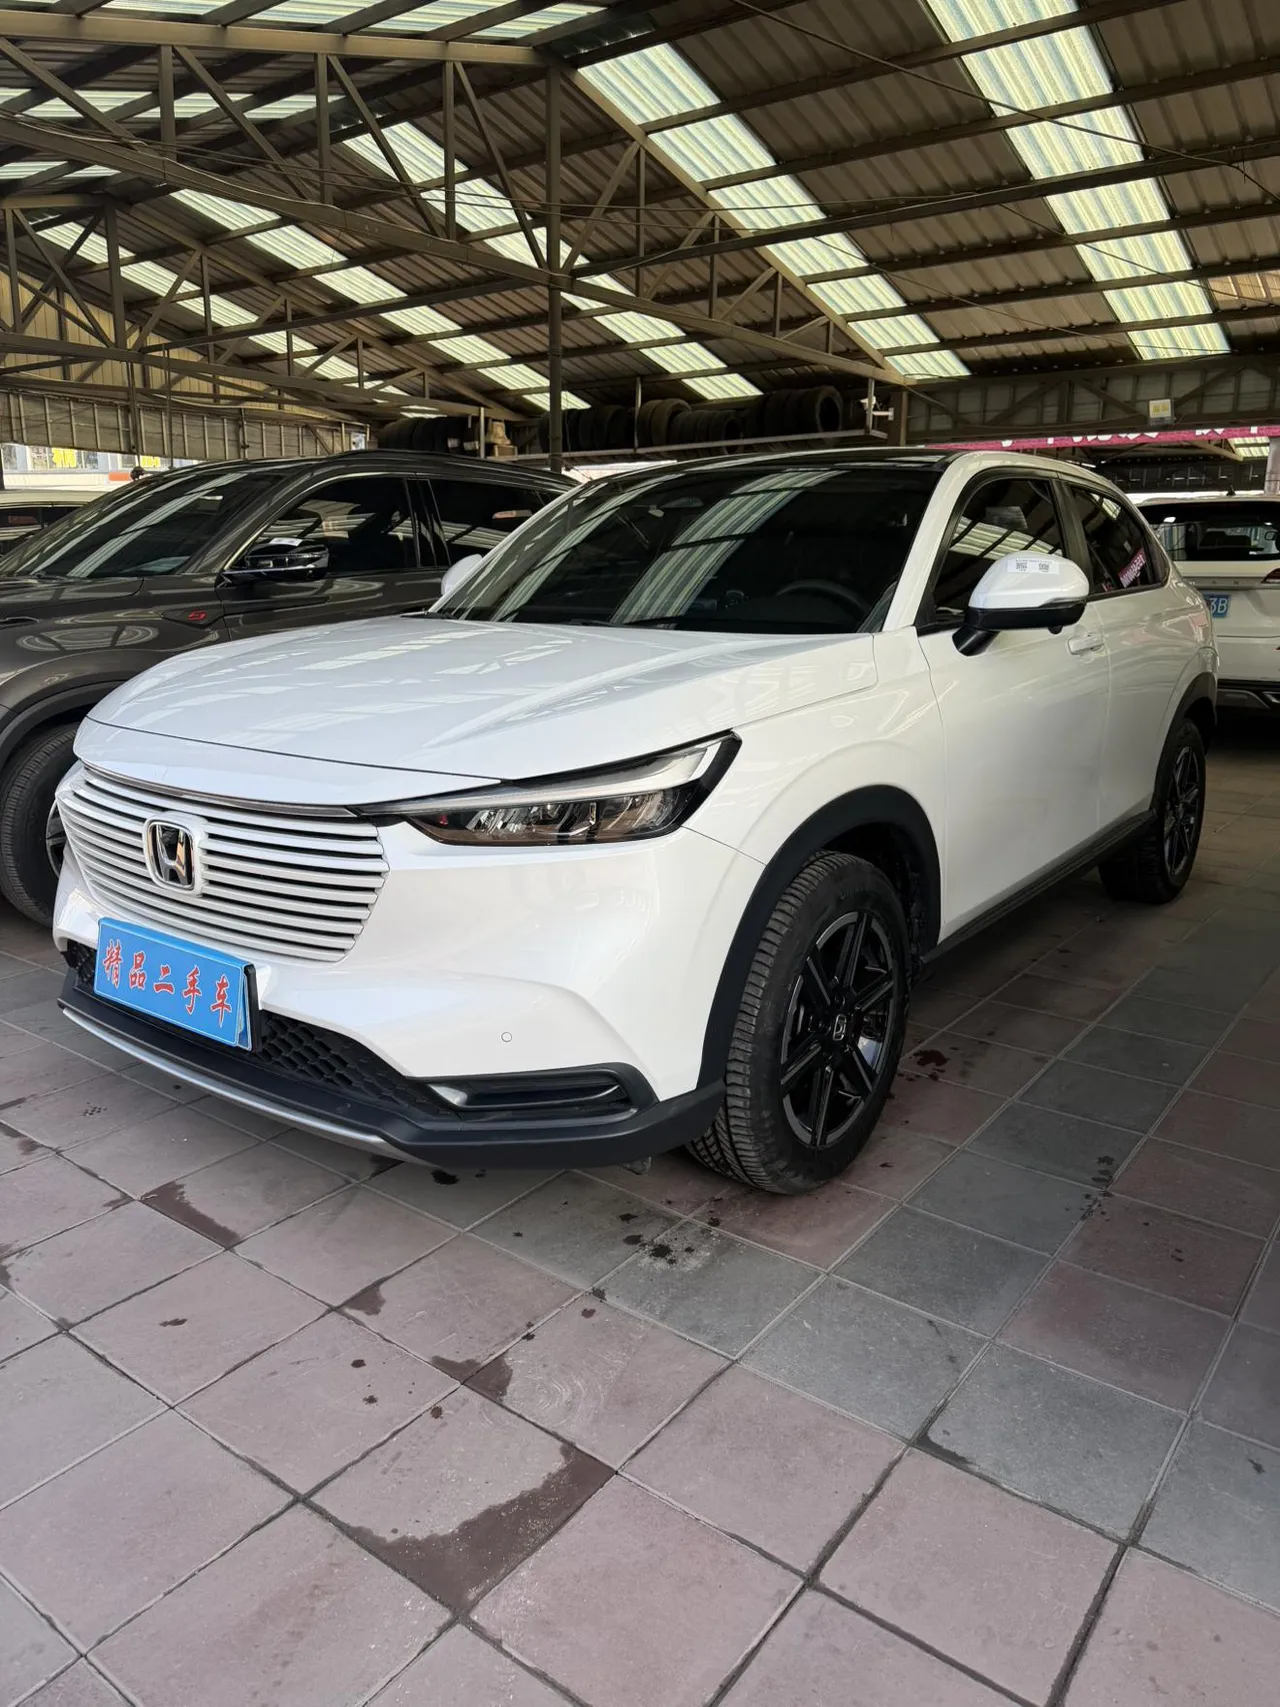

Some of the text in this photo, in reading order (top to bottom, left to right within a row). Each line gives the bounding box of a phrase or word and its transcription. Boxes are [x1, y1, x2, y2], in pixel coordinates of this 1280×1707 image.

[103, 939, 232, 1028] 精品二手车
